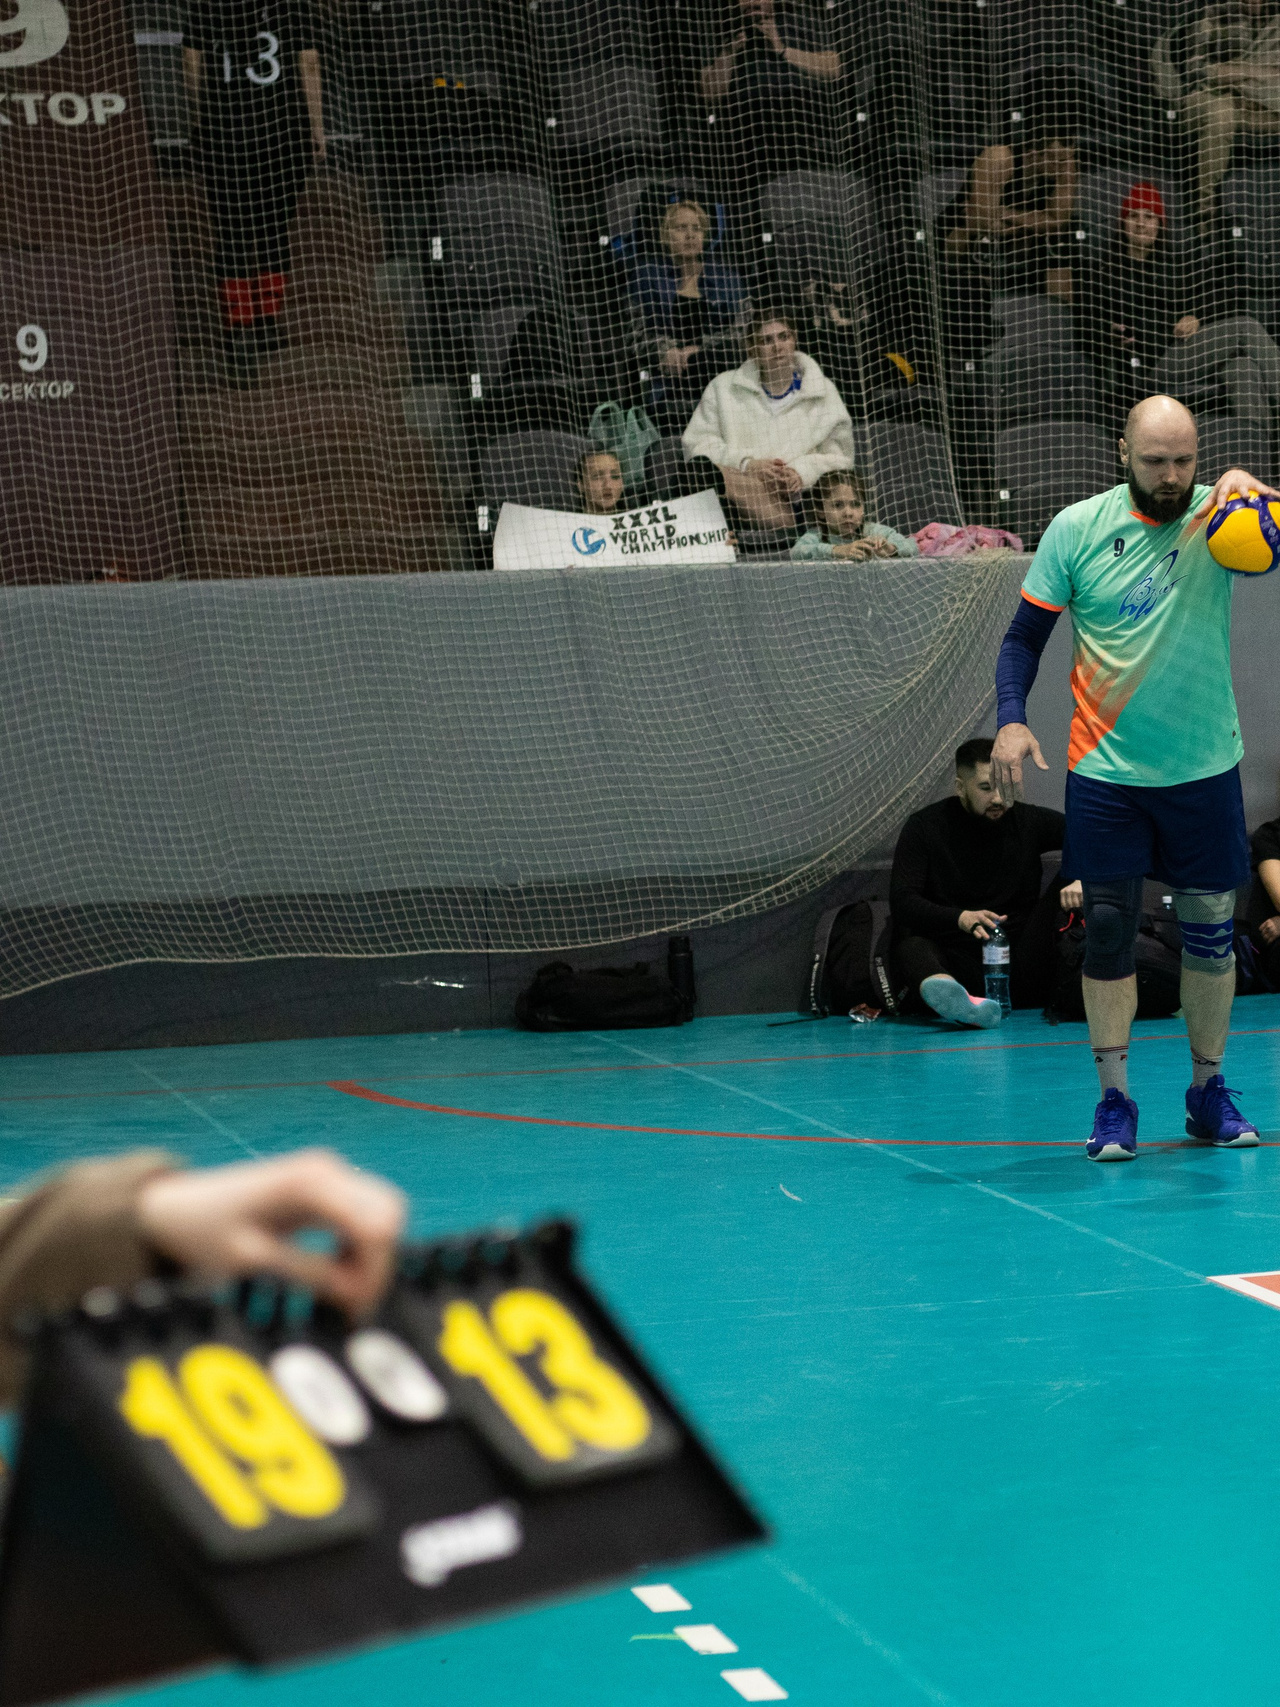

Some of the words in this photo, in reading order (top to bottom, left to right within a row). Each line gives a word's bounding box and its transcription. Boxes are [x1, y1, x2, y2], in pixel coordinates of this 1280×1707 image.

[16, 324, 48, 372] 9
[0, 381, 74, 400] СЕКТОР
[611, 506, 677, 530] XXXL
[609, 524, 676, 546] WORLD
[621, 527, 728, 555] CHAMPIONSHIP
[1113, 537, 1126, 558] 9
[119, 1344, 346, 1530] 19
[439, 1288, 651, 1462] 13
